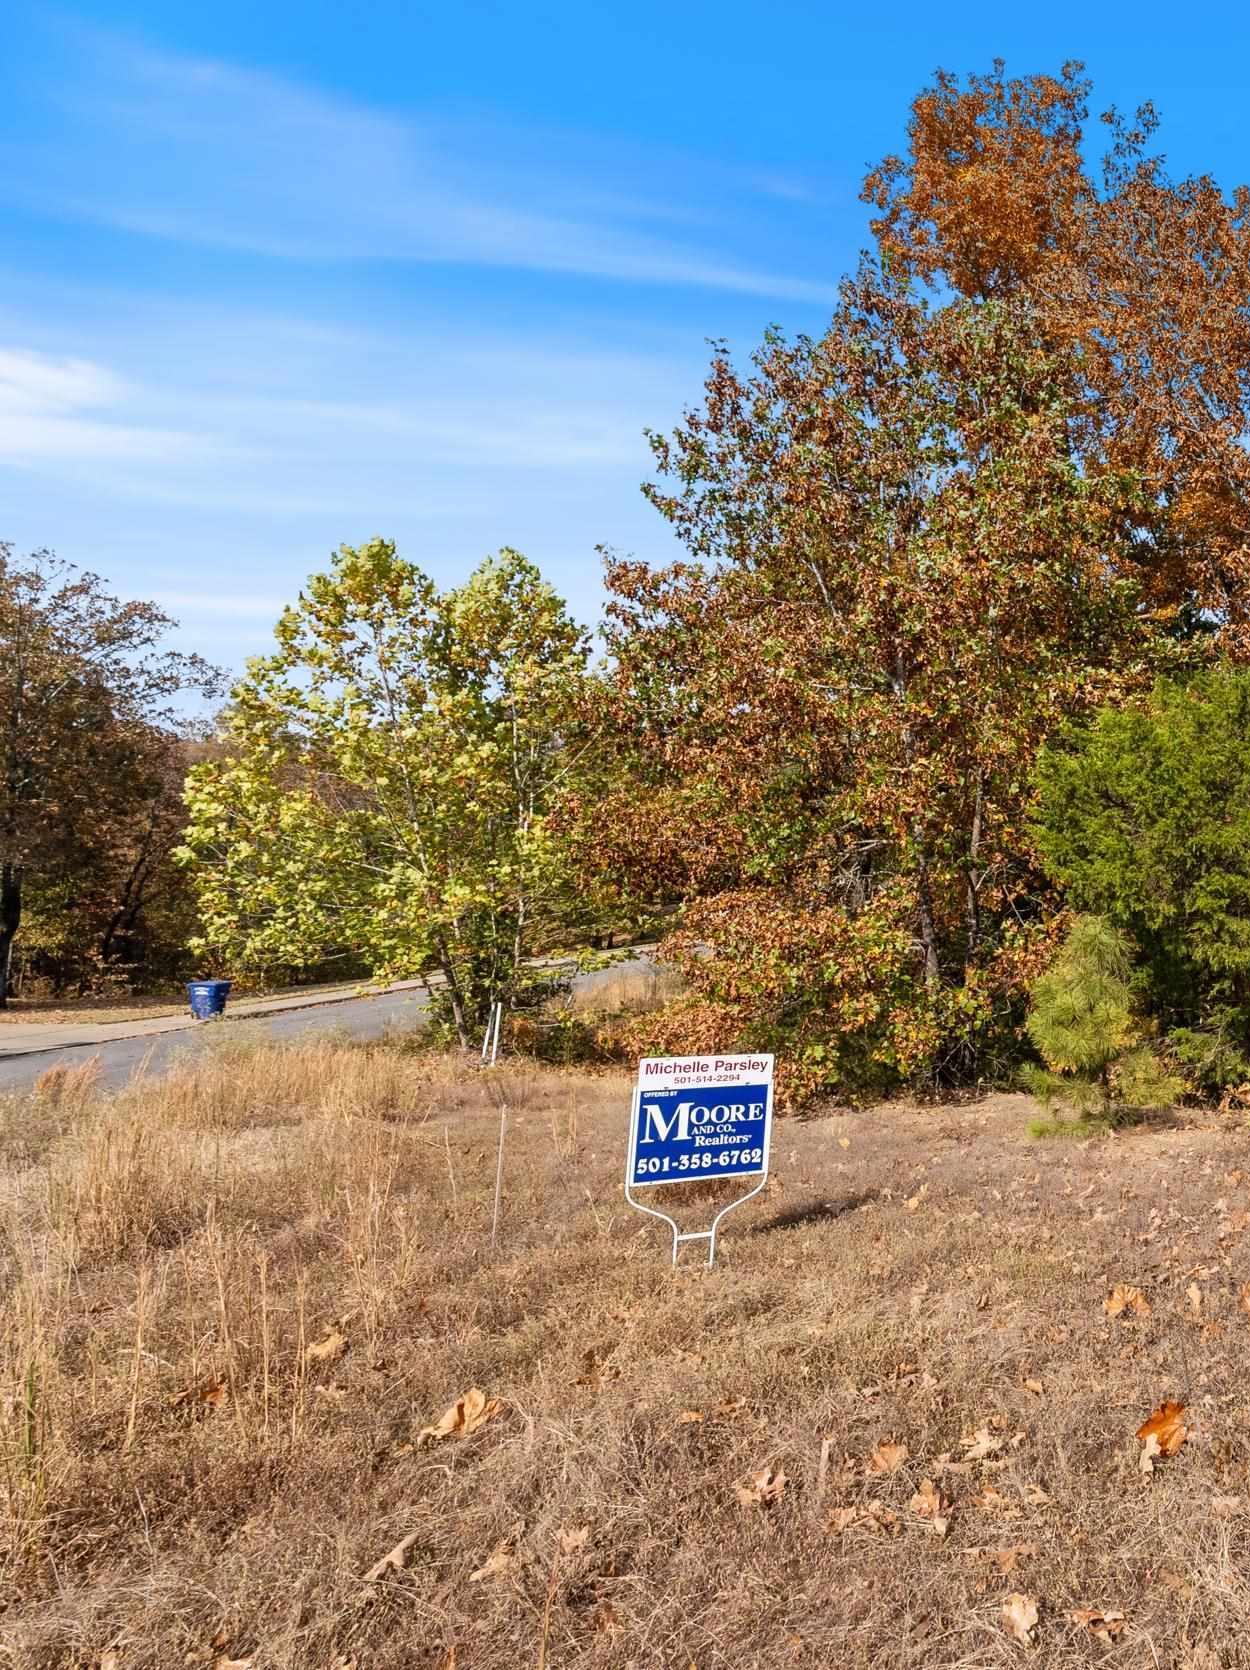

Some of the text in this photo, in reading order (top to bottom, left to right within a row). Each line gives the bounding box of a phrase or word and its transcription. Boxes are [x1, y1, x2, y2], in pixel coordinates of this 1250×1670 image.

[645, 1059, 768, 1075] Michelle Parsley
[673, 1074, 740, 1084] 501-514-2294
[639, 1102, 764, 1144] MOORE
[691, 1125, 714, 1135] AND
[636, 1148, 762, 1174] 501-358-6762
